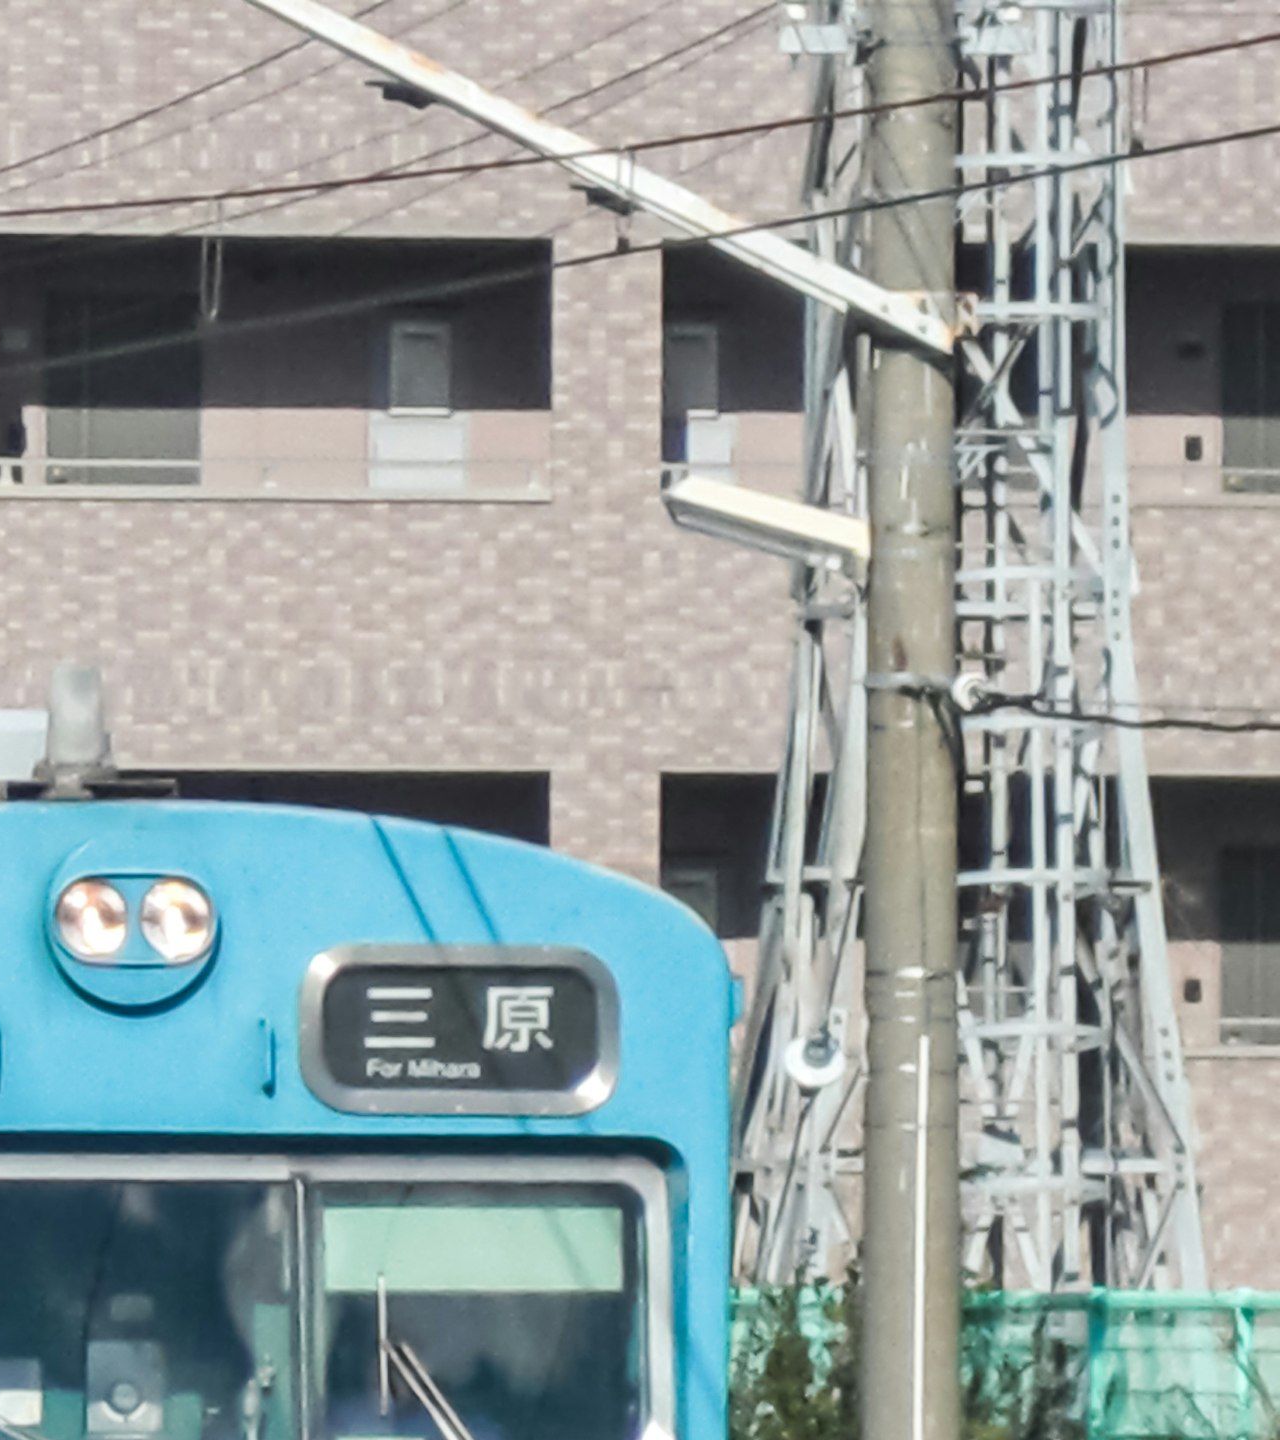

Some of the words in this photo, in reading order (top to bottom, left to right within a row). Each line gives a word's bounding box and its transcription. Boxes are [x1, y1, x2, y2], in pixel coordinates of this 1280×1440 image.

[363, 986, 555, 1053] 三原
[366, 1057, 403, 1079] For
[407, 1057, 482, 1079] Mihara
